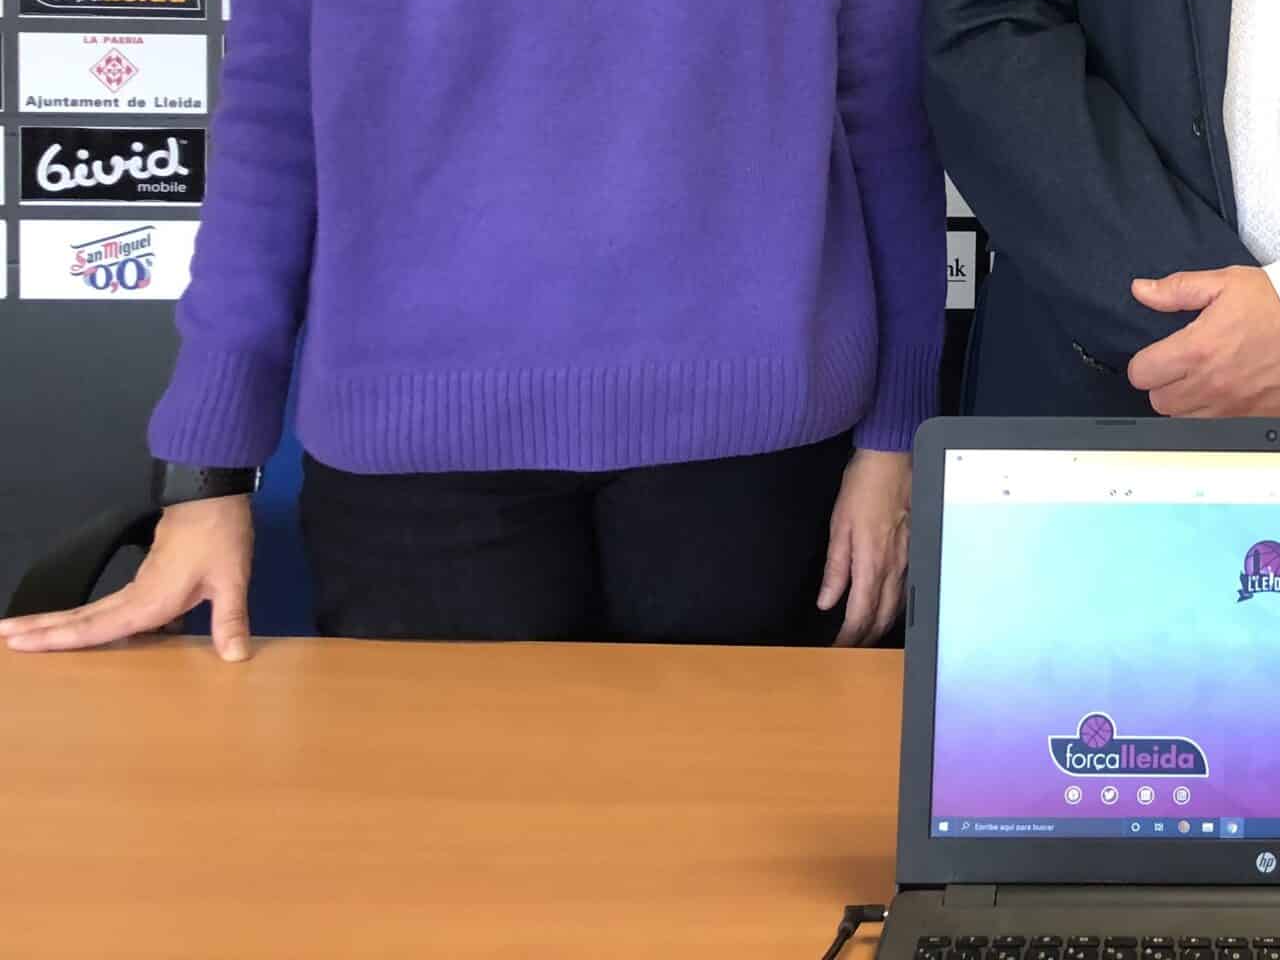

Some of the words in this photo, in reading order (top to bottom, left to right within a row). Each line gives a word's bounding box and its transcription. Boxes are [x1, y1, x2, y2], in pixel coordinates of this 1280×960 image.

[83, 36, 98, 44] LA
[103, 36, 144, 45] PAERIA
[25, 95, 119, 108] Ajuntament
[127, 96, 146, 108] de
[154, 96, 202, 109] Lleida
[137, 180, 187, 193] mobile
